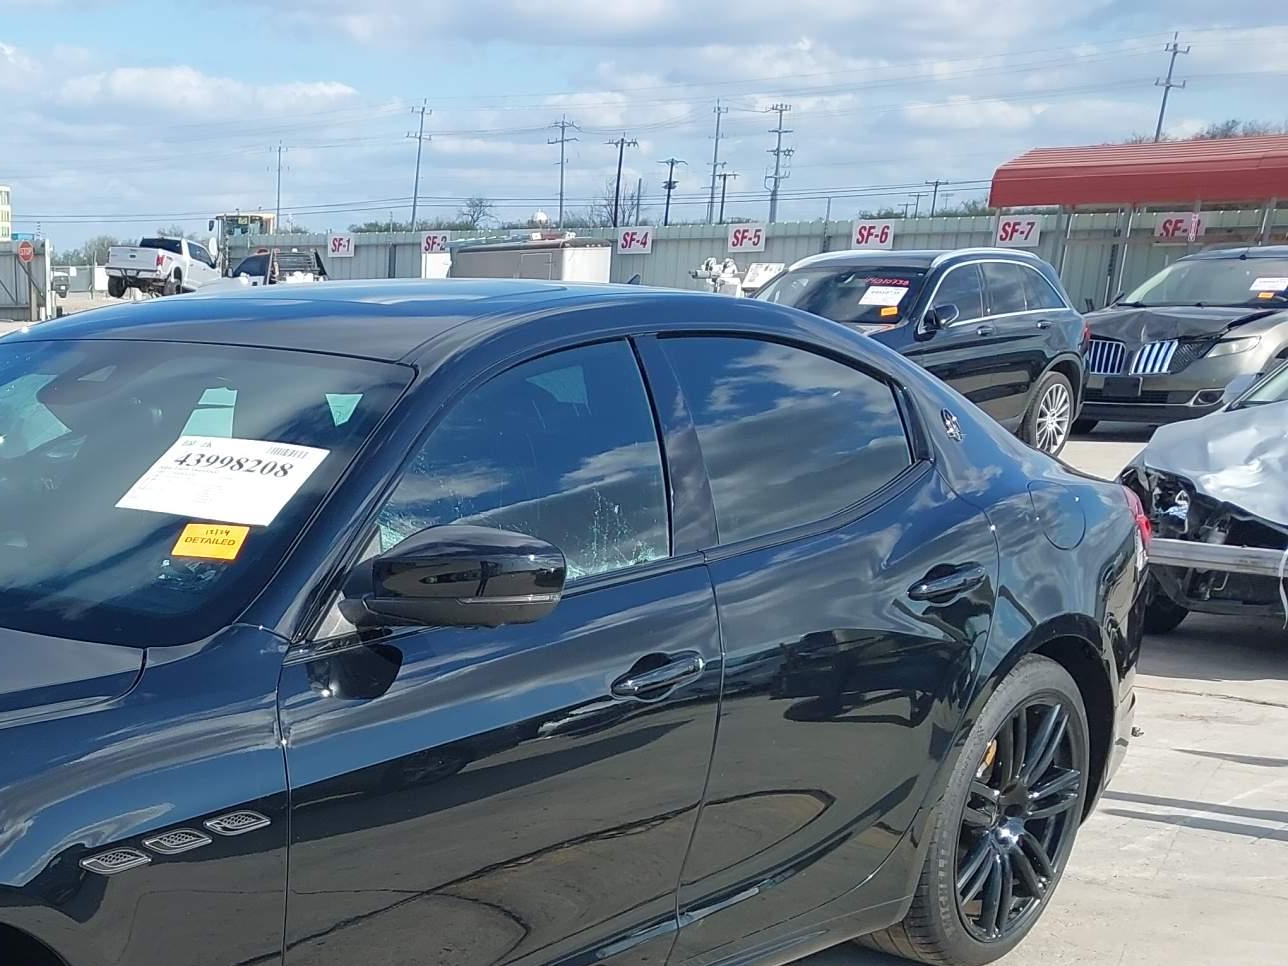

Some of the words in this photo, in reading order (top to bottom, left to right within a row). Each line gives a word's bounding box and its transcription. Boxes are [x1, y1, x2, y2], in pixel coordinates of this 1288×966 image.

[621, 231, 649, 249] SF-4
[731, 228, 762, 247] SF-5
[856, 225, 890, 245] SF-6
[999, 221, 1035, 242] SF-7
[331, 237, 351, 253] SF-1
[424, 235, 447, 252] SF-2
[174, 452, 294, 478] 43998208
[184, 536, 236, 547] DETAILED
